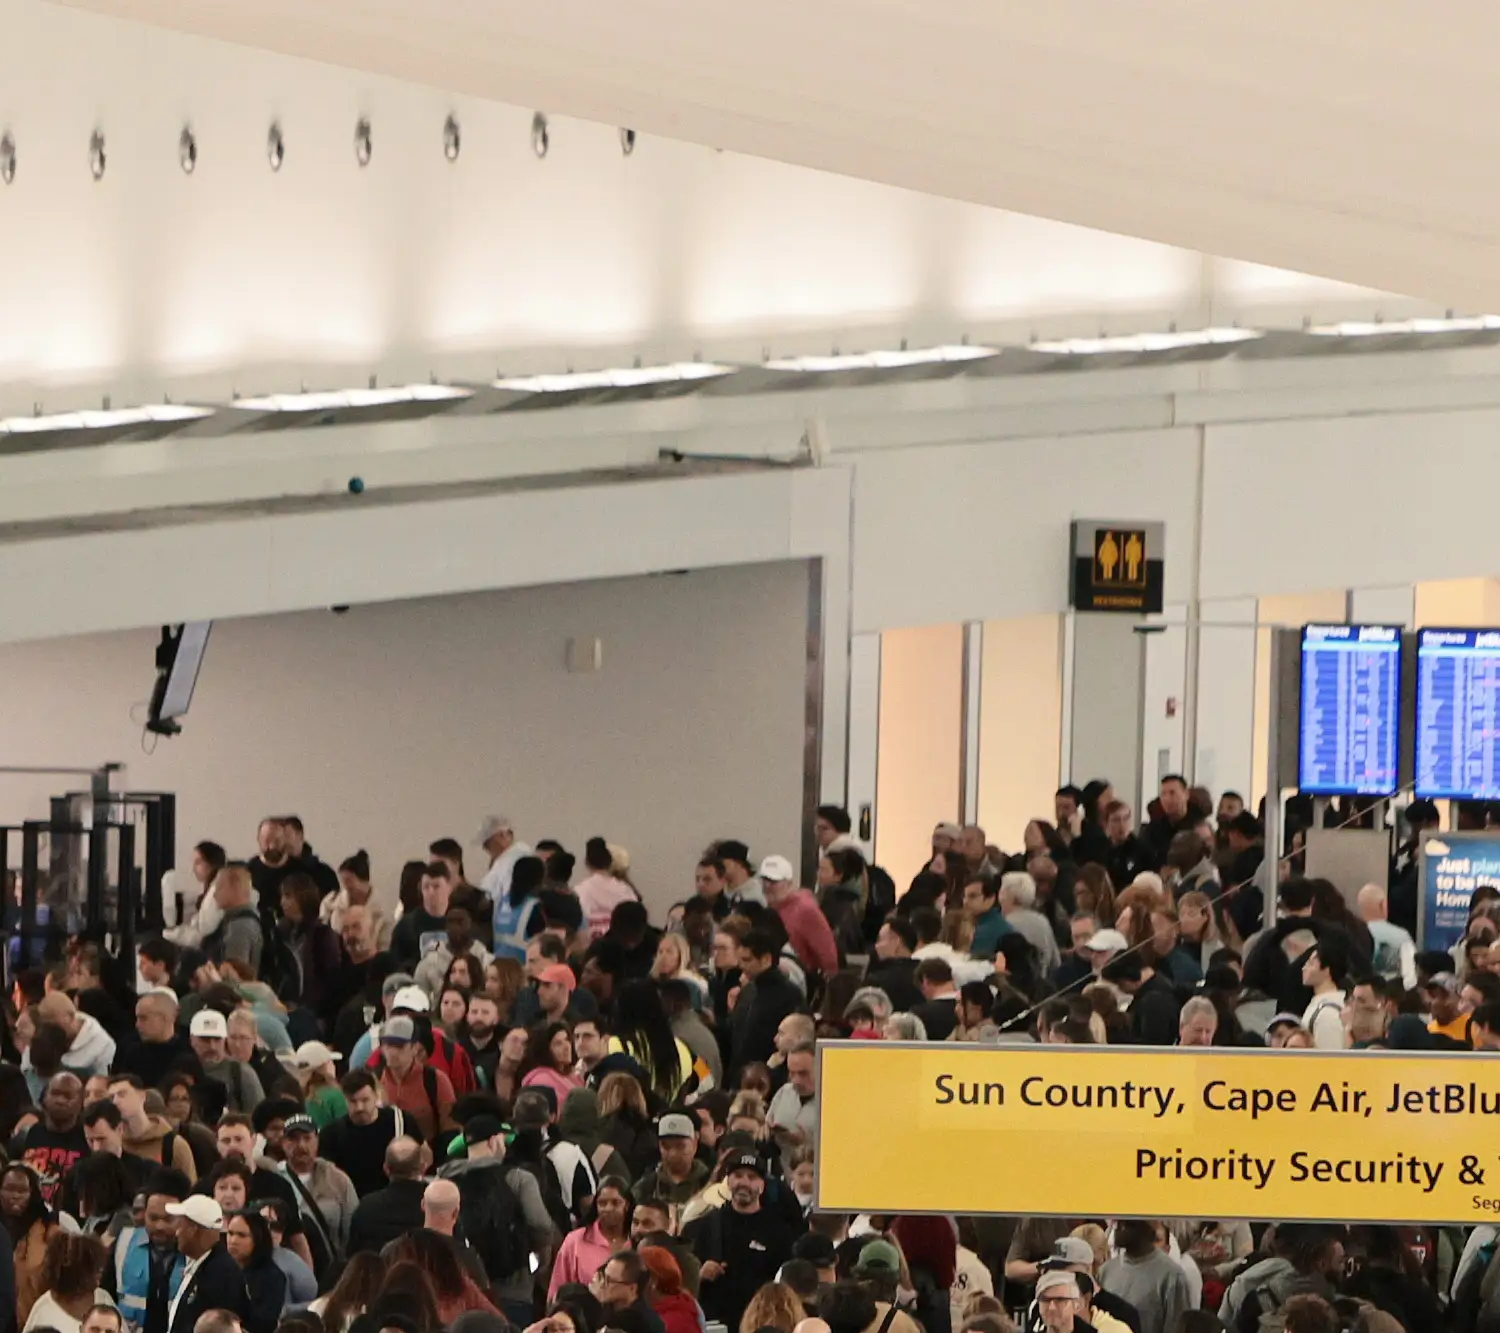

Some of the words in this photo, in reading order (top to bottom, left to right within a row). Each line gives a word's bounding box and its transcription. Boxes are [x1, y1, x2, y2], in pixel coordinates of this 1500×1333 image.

[1436, 858, 1471, 875] Just
[935, 1074, 1006, 1107] Sun
[1020, 1076, 1187, 1118] Country,
[1202, 1081, 1297, 1120] Cape
[1310, 1081, 1374, 1120] Air,
[1135, 1148, 1275, 1190] Priority
[1288, 1150, 1447, 1194] Security
[1458, 1156, 1486, 1187] &
